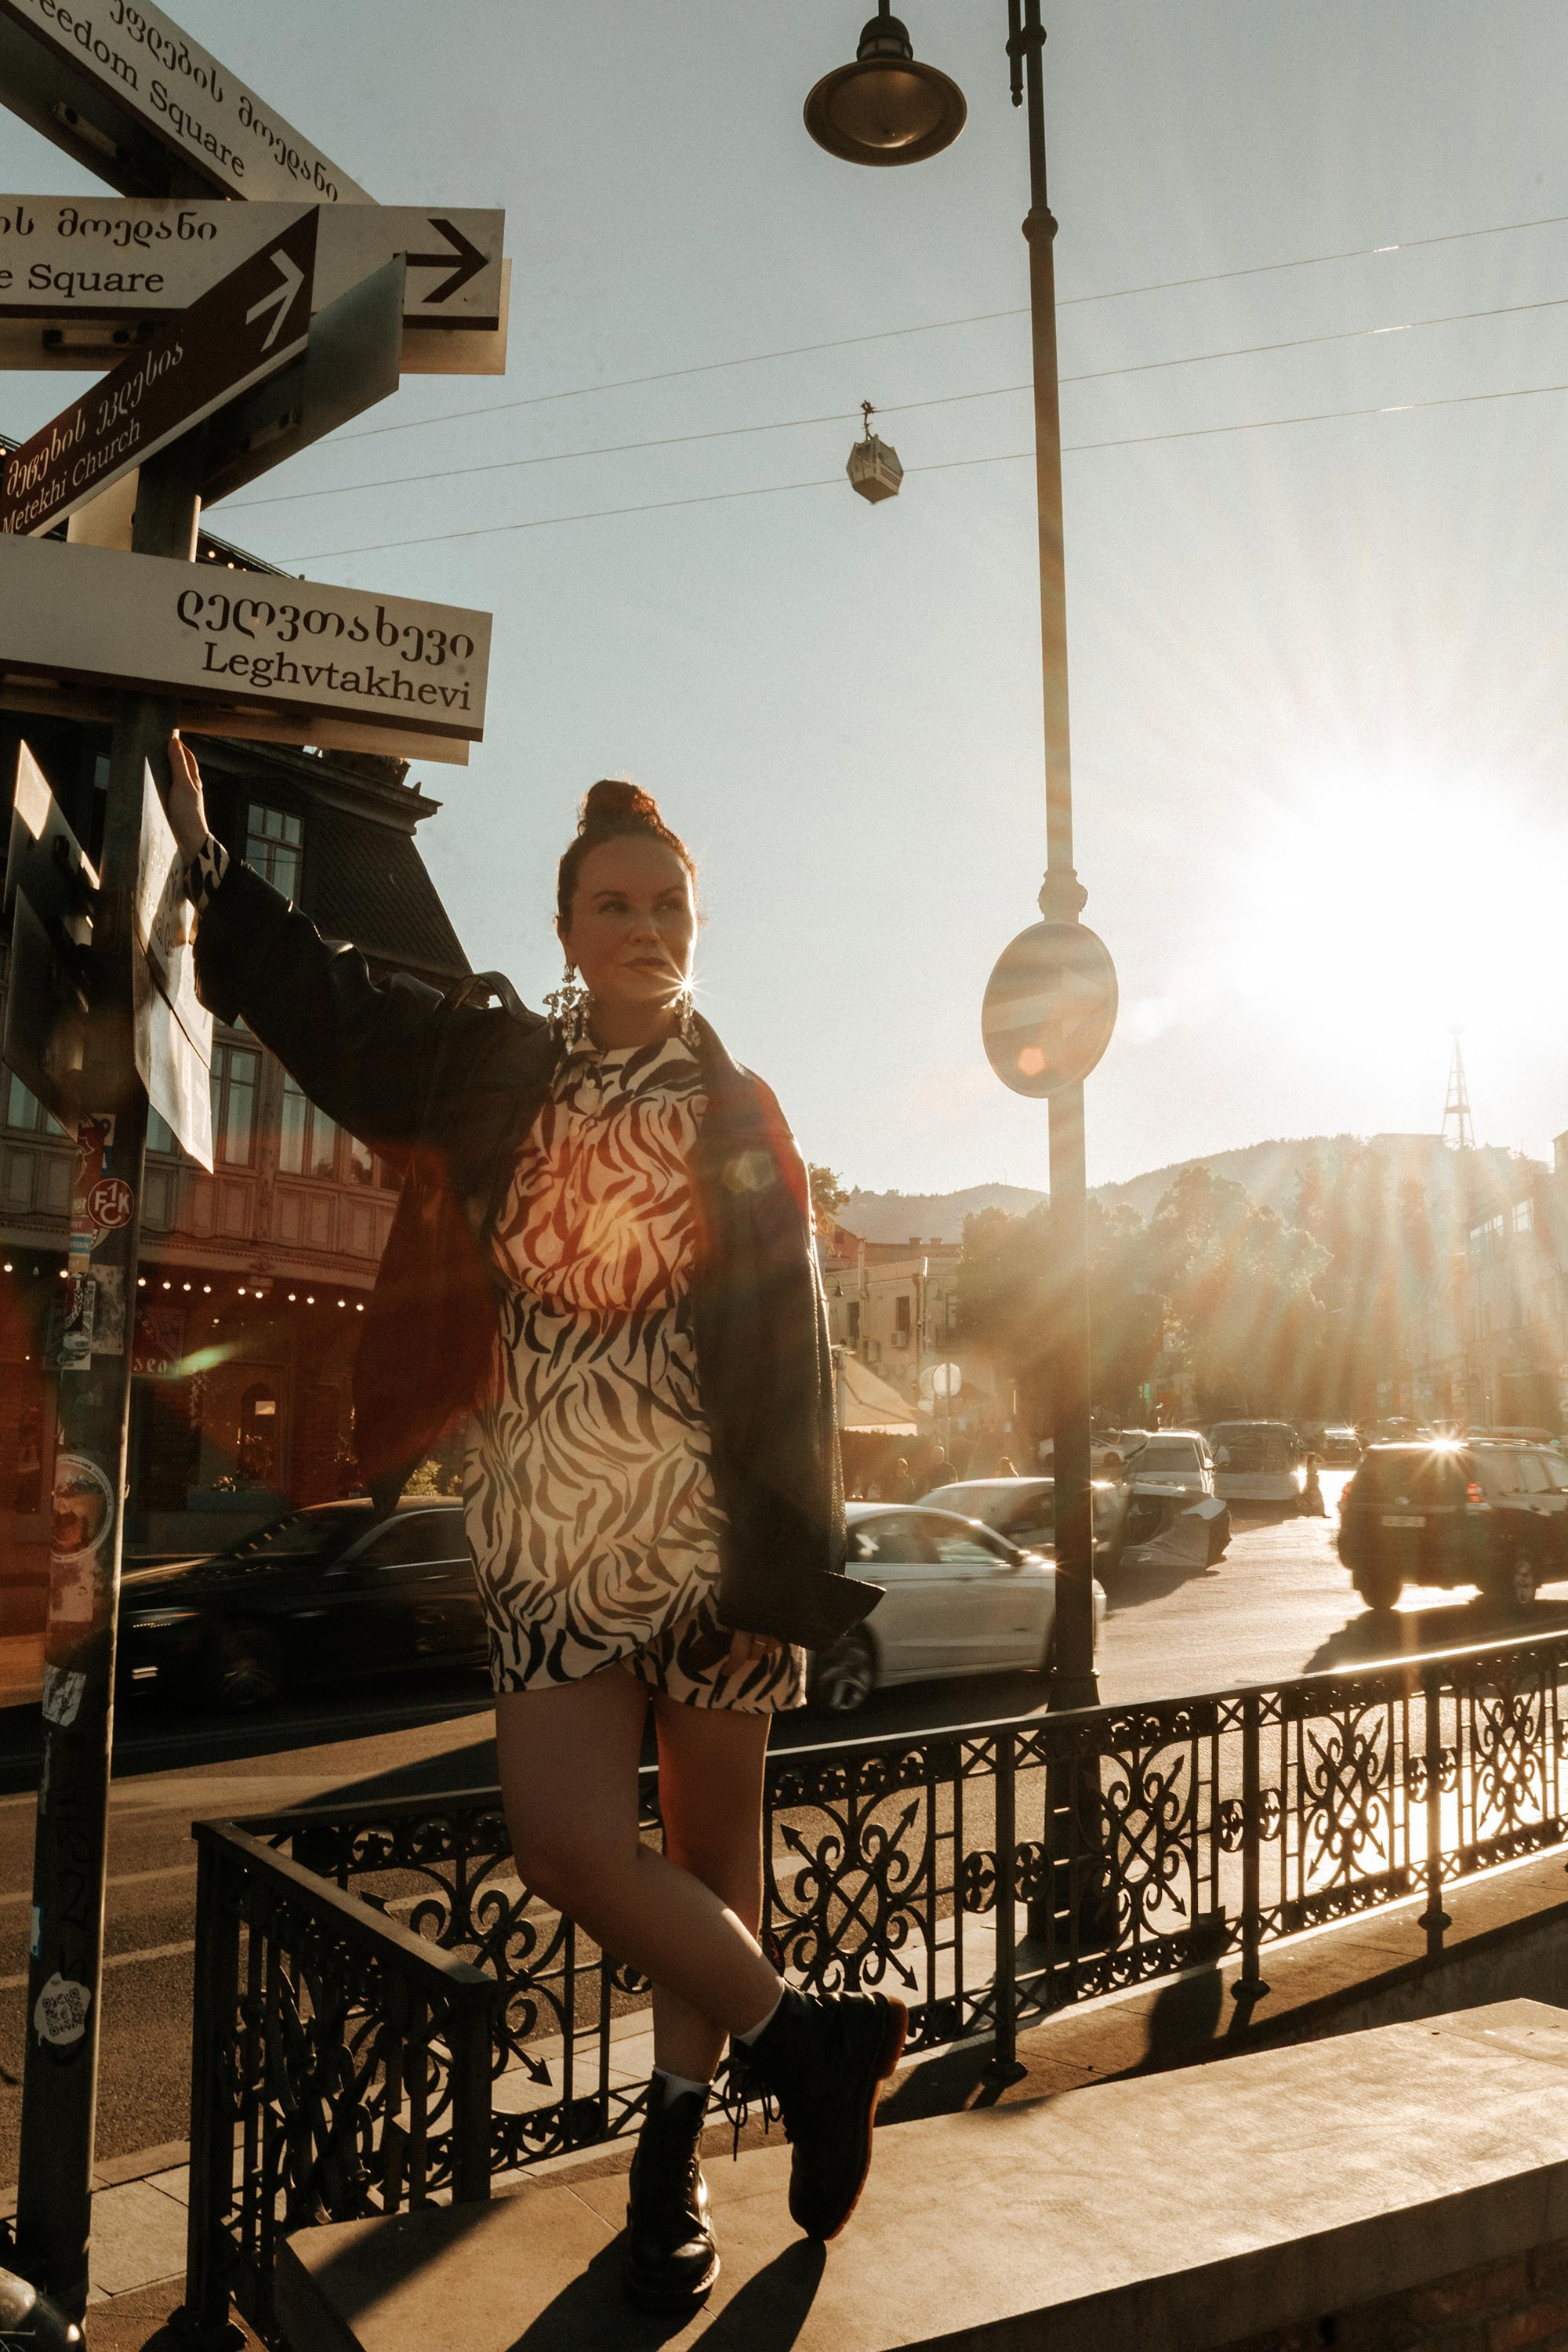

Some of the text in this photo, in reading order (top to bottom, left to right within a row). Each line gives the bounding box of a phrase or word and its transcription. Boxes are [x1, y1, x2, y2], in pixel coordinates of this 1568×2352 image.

[31, 0, 245, 177] eedom Square
[238, 96, 339, 202] მოედანი
[57, 207, 218, 249] მოედანი
[28, 263, 164, 299] Square
[2, 417, 141, 534] Metekhi Church
[201, 641, 471, 711] Leghvtakhevi
